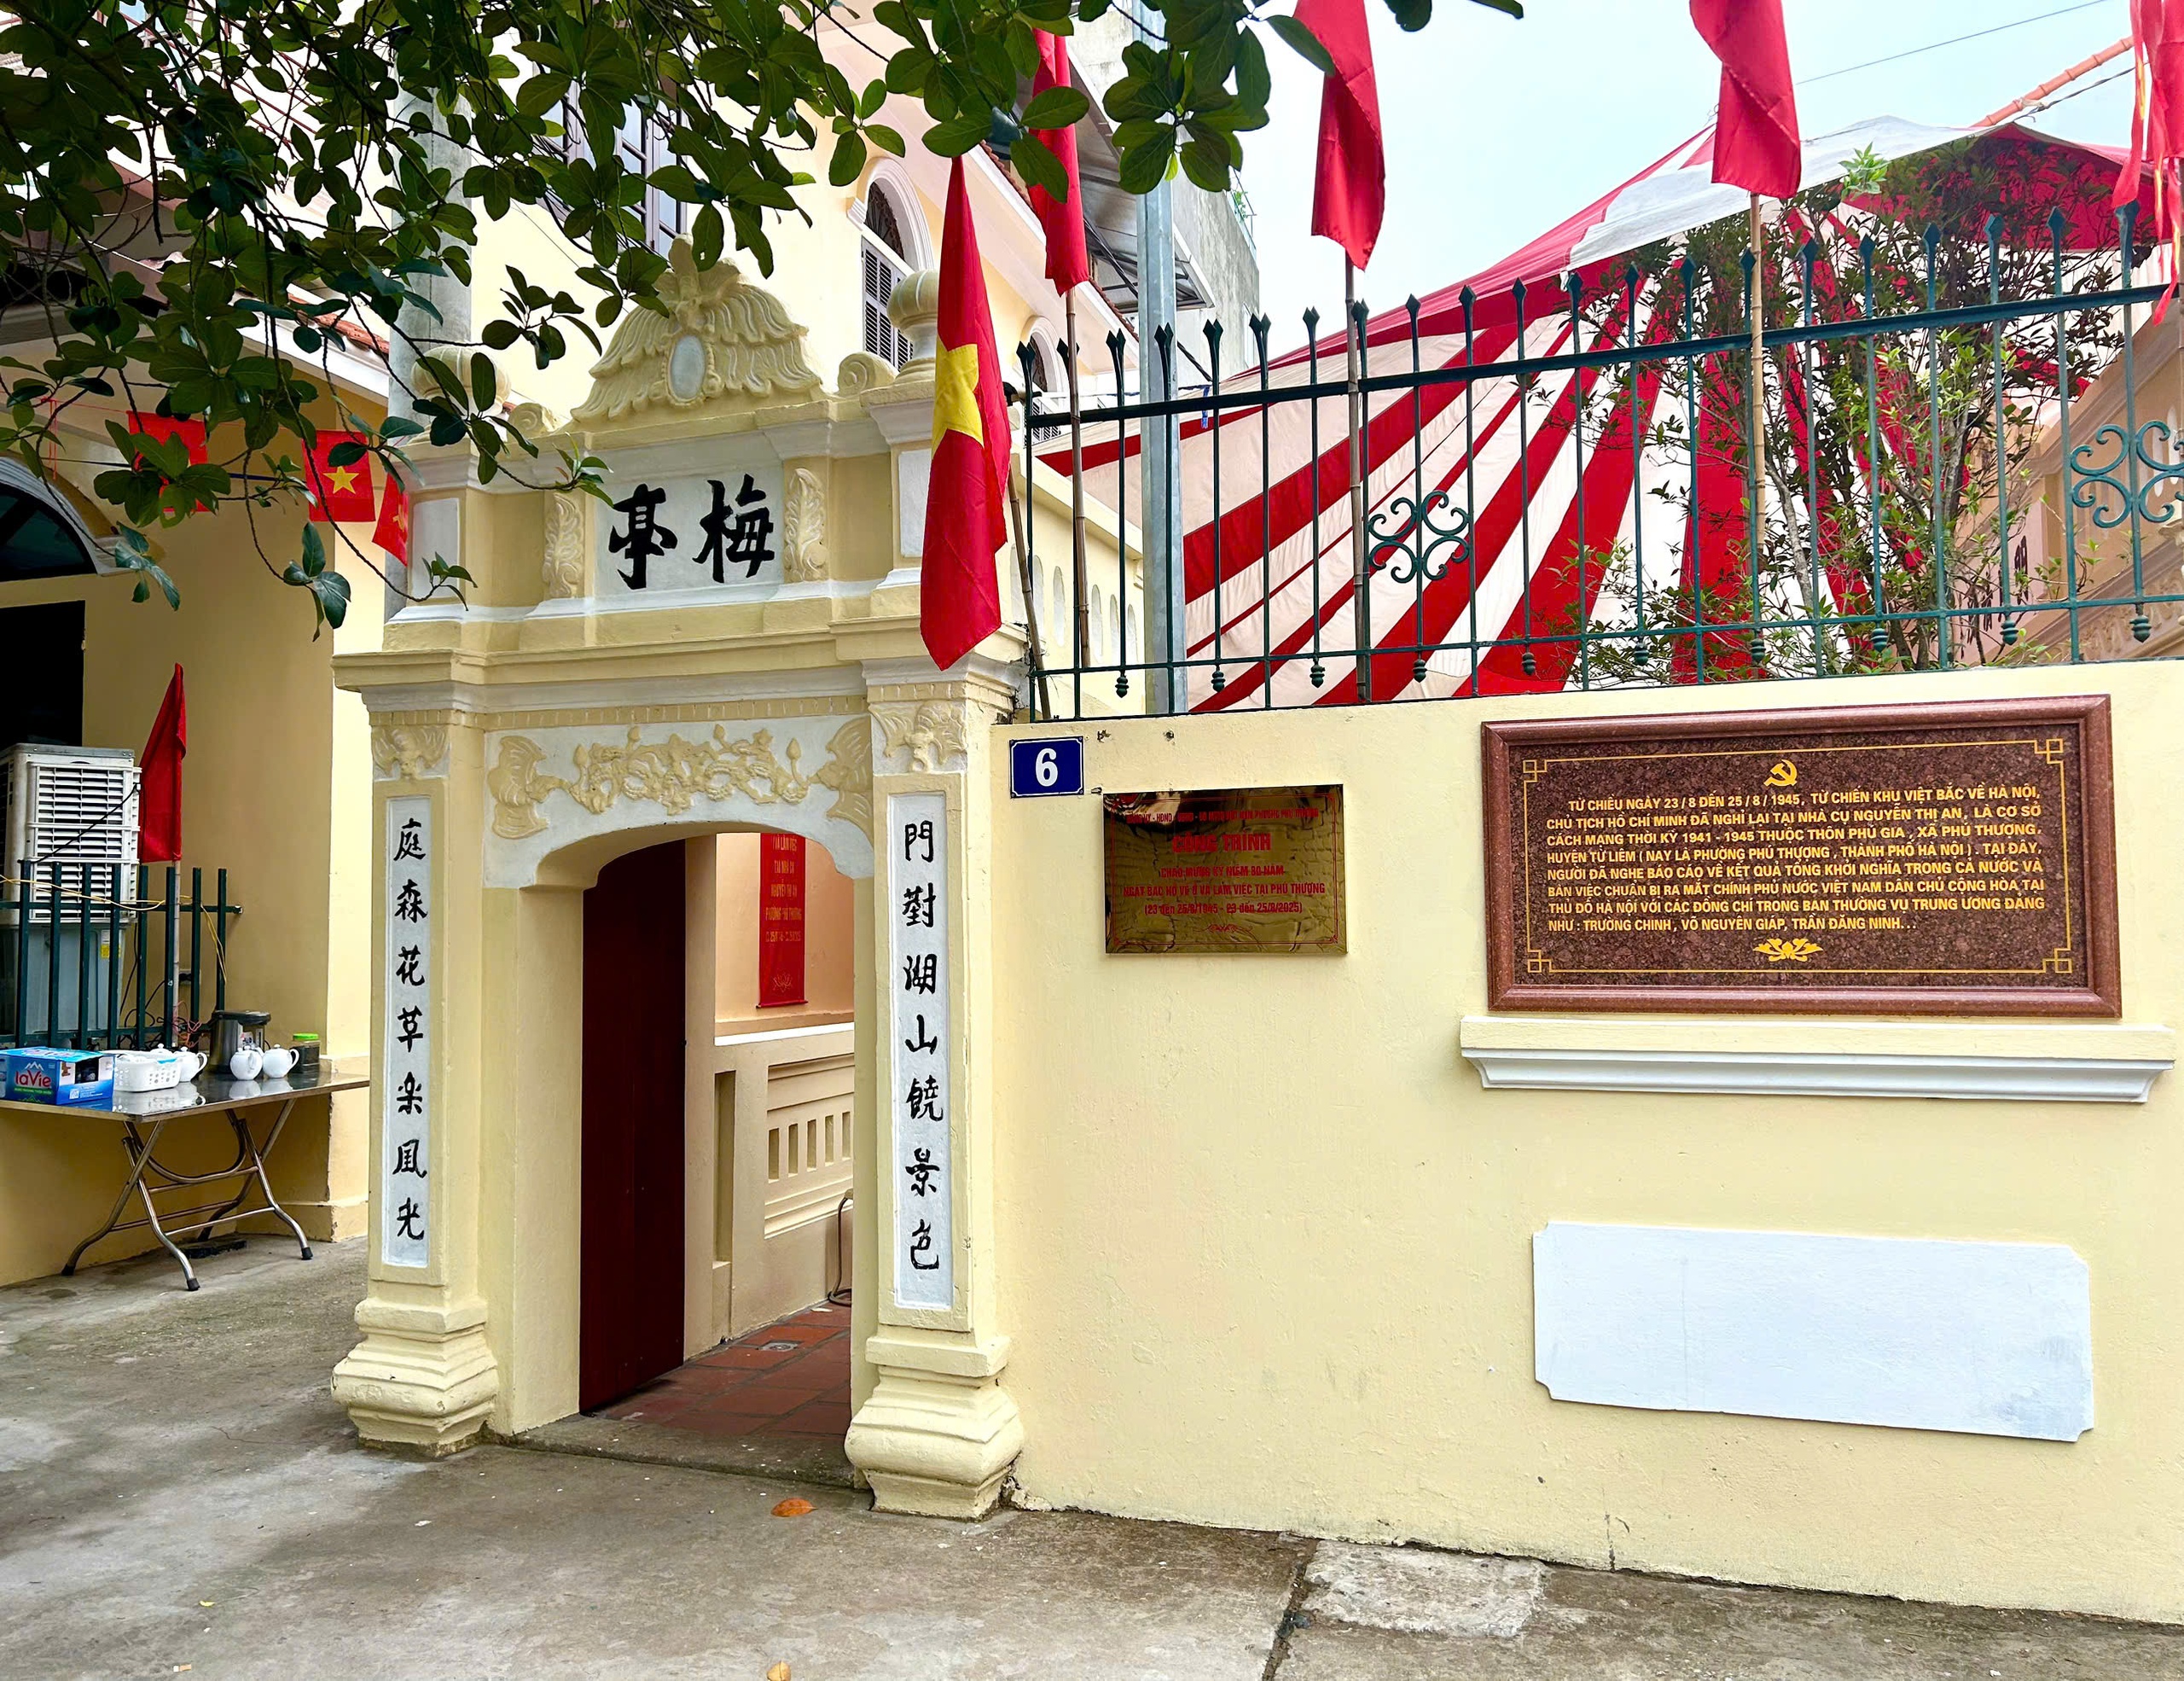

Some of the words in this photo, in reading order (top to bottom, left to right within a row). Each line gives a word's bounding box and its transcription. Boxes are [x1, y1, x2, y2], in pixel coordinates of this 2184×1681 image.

[1036, 748, 1059, 787] 6
[1569, 797, 1586, 811] TỪ
[1588, 793, 1623, 811] CHIỀU
[1626, 794, 1661, 809] NGÀY
[1664, 798, 1678, 808] 23
[1699, 790, 1724, 807] ĐẾN
[1728, 795, 1742, 806] 25
[1810, 788, 1828, 804] TỪ
[1831, 785, 1869, 803] CHIẾN
[1873, 790, 1901, 802] KHU
[1903, 786, 1933, 804] VIỆT
[1936, 782, 1964, 800] BẮC
[1966, 782, 1985, 799] VỀ
[1988, 783, 2008, 799] HÀ
[2012, 782, 2041, 801] NỘI,
[1546, 814, 1572, 829] CHỦ
[1576, 817, 1604, 831] TỊCH
[1607, 811, 1626, 827] HỒ
[1629, 813, 1651, 827] CHÍ
[1653, 815, 1687, 827] MINH
[1690, 811, 1710, 826] ĐÃ
[1712, 809, 1745, 825] NGHỈ
[1748, 813, 1769, 827] LẠI
[1772, 811, 1795, 827] TẠI
[1798, 808, 1827, 823] NHÀ
[1830, 810, 1850, 825] CỤ
[1853, 802, 1912, 822] NGUYỄN
[1914, 808, 1937, 822] THỊ
[1973, 804, 1993, 818] LÀ
[1996, 806, 2018, 817] CƠ
[2020, 800, 2042, 817] SỞ
[1547, 832, 1582, 846] CÁCH
[1584, 834, 1624, 848] MẠNG
[1626, 830, 1657, 845] THỜI
[1660, 829, 1678, 844] KỲ
[1682, 832, 1711, 843] 1941
[1724, 831, 1755, 842] 1945
[1757, 827, 1804, 844] THUỘC
[1807, 825, 1844, 840] THÔN
[1848, 824, 1877, 840] PHÚ
[1917, 823, 1938, 837] XÃ
[1942, 822, 1972, 837] PHÚ
[1547, 849, 1587, 865] HUYỆN
[1589, 848, 1606, 863] TỪ
[1609, 847, 1635, 862] LIÊM
[1646, 850, 1672, 862] NAY
[1675, 846, 1691, 861] LÀ
[1693, 846, 1745, 860] PHƯỜNG
[1749, 845, 1774, 859] PHÚ
[1840, 842, 1885, 858] THÀNH
[1888, 839, 1915, 857] PHỐ
[1918, 841, 1937, 856] HÀ
[1982, 842, 2005, 858] TẠI
[1547, 865, 1586, 880] NGƯỜI
[1589, 865, 1607, 880] ĐÃ
[1610, 868, 1644, 879] NGHE
[1647, 864, 1674, 879] BÁO
[1676, 864, 1704, 878] CÁO
[1706, 860, 1723, 878] VỀ
[1726, 860, 1751, 877] KẾT
[1753, 860, 1782, 877] QUẢ
[1785, 858, 1821, 876] TỔNG
[1824, 858, 1856, 875] KHỞI
[1859, 859, 1902, 875] NGHĨA
[1904, 862, 1952, 875] TRONG
[1955, 857, 1976, 871] CẢ
[1978, 857, 2019, 873] NƯỚC
[2022, 857, 2043, 872] VÀ
[1548, 884, 1572, 897] BÀN
[1575, 883, 1602, 899] VIỆC
[1604, 879, 1647, 896] CHUẨN
[1649, 885, 1661, 899] BỊ
[1664, 885, 1681, 896] RA
[1683, 879, 1711, 895] MẮT
[1713, 881, 1751, 895] CHÍNH
[1753, 879, 1780, 894] PHỦ
[1782, 880, 1818, 894] NƯỚC
[1821, 879, 1849, 896] VIỆT
[1851, 881, 1882, 893] NAM
[1885, 878, 1914, 893] DÂN
[1916, 876, 1945, 893] CHỦ
[1948, 877, 1986, 895] CỘNG
[1989, 876, 2018, 892] HÒA
[2021, 879, 2045, 894] TẠI
[1548, 899, 1572, 914] THỦ
[1596, 899, 1613, 914] HÀ
[1616, 899, 1637, 917] NỘI
[1640, 899, 1661, 913] VỚI
[1664, 898, 1690, 912] CÁC
[1693, 895, 1729, 912] ĐỒNG
[1732, 897, 1753, 912] CHÍ
[1756, 900, 1799, 911] TRONG
[1802, 899, 1829, 911] BAN
[1832, 895, 1887, 910] THƯỜNG
[1890, 899, 1909, 914] VỤ
[1911, 898, 1958, 910] TRUNG
[1961, 896, 2001, 910] ƯƠNG
[2004, 892, 2046, 910] ĐẢNG
[1583, 916, 1632, 931] TRƯỜNG
[1681, 916, 1699, 931] VÕ
[1701, 915, 1752, 930] NGUYÊN
[1792, 913, 1826, 929] TRẦN
[1828, 914, 1866, 929] ĐĂNG
[15, 1070, 51, 1088] laVie
